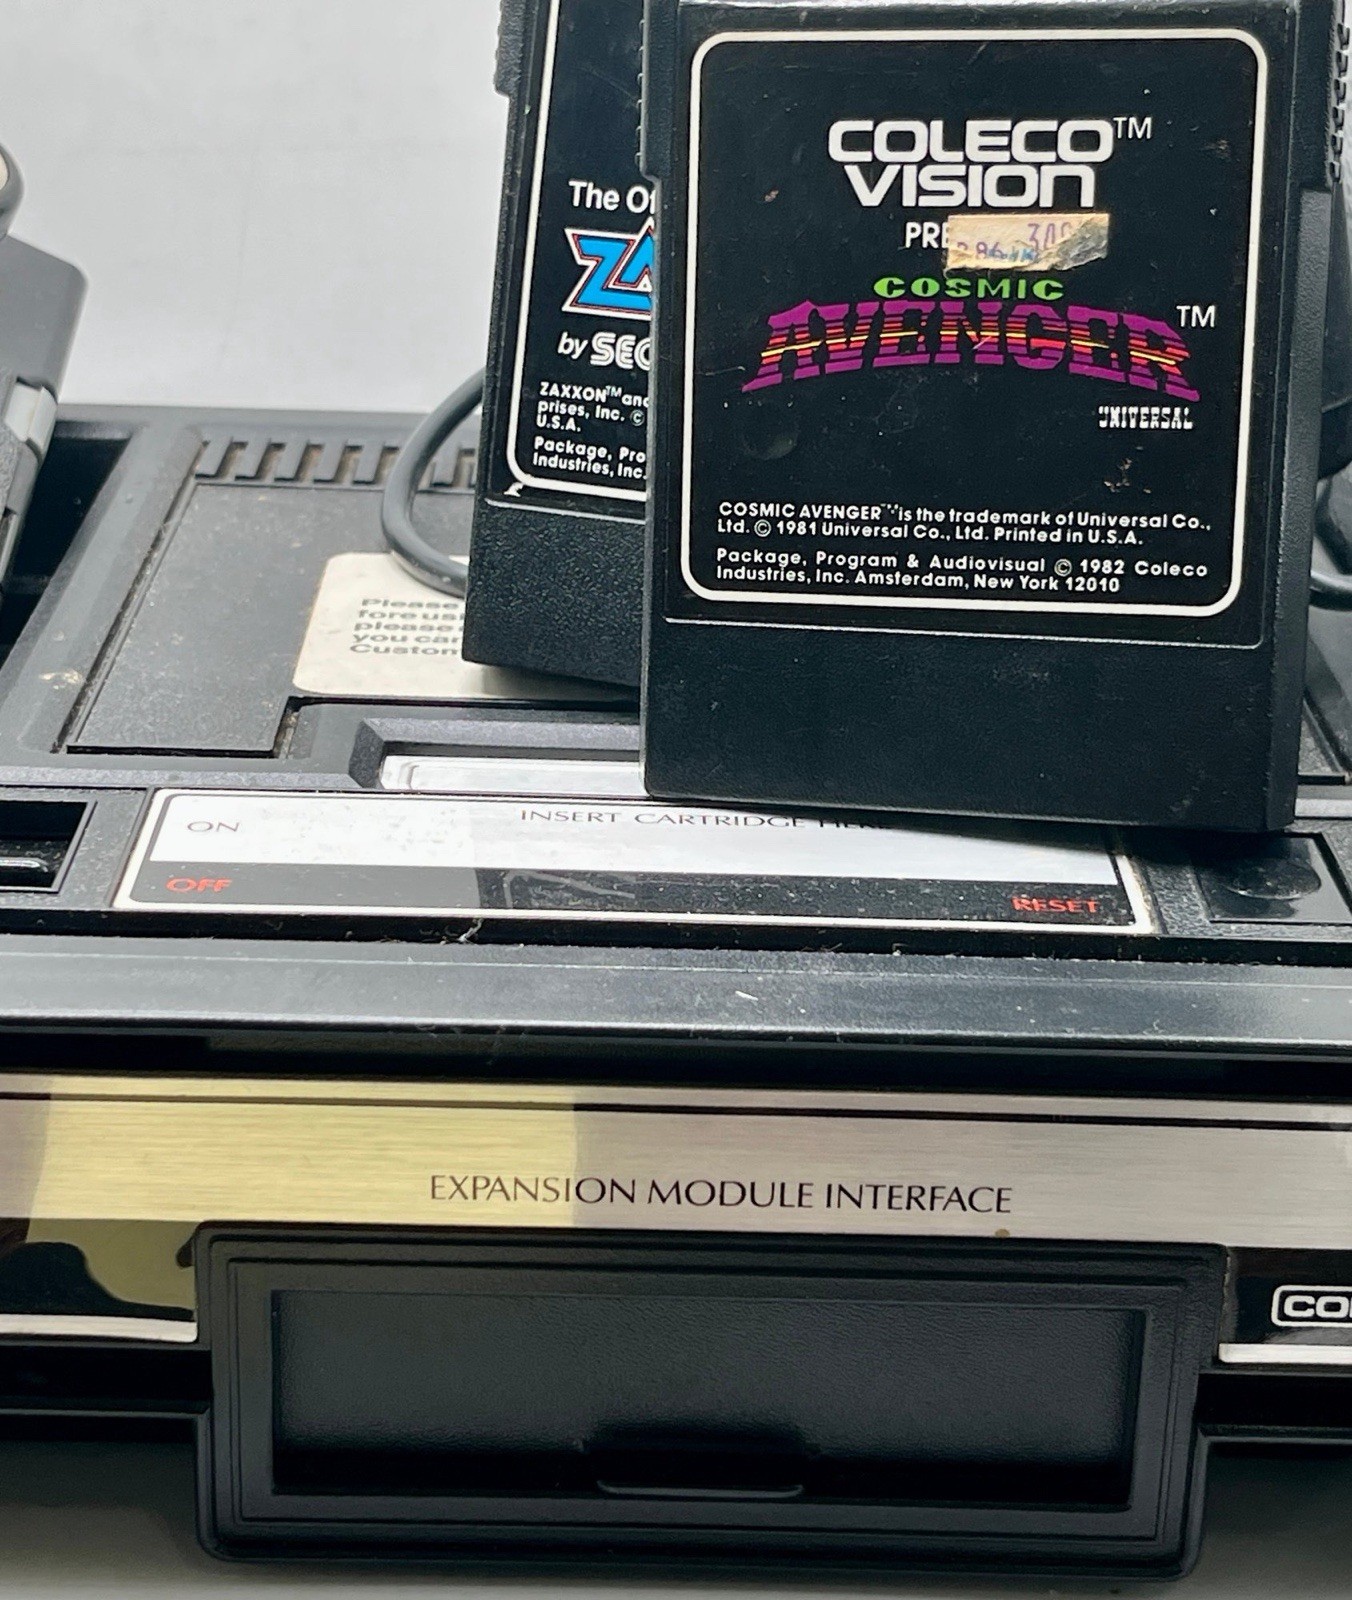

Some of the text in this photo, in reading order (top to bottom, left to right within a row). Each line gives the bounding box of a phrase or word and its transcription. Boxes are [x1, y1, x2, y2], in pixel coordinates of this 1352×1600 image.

[828, 119, 1114, 163] COLECO
[568, 180, 621, 211] The
[844, 164, 1096, 208] VISION
[873, 276, 1065, 300] COSMIC
[557, 330, 588, 360] by
[741, 299, 1216, 402] AVENGER TM
[536, 413, 581, 432] U.S.A.
[537, 400, 590, 420] prises,
[595, 404, 625, 422] Inc.
[1098, 405, 1193, 430] UNIVERSAL
[533, 435, 612, 462] Package,
[532, 452, 648, 480] Industries, Inc.
[719, 502, 795, 518] COSMIC
[898, 506, 912, 521] is
[916, 507, 945, 523] the
[949, 508, 1051, 526] trademark
[1055, 511, 1074, 526] of
[1077, 511, 1168, 528] Universal
[1171, 513, 1211, 532] Co.,
[717, 518, 750, 534] Ltd.
[776, 520, 818, 537] 1981
[821, 520, 909, 538] Universal
[913, 524, 951, 542] Co.,
[955, 525, 990, 541] Ltd.
[994, 526, 1062, 543] Printed
[1066, 529, 1083, 544] in
[1088, 529, 1144, 545] U.S.A.
[716, 547, 807, 568] Package,
[816, 550, 898, 571] Program
[906, 553, 920, 569] &
[929, 554, 1045, 573] Audiovisual
[1080, 558, 1125, 575] 1982
[1134, 560, 1208, 577] Coleco
[716, 565, 1120, 592] Industries, Inc. Amsterdam, New York 12010
[359, 609, 418, 619] fore
[361, 598, 459, 610] Please
[353, 633, 409, 643] you
[354, 620, 454, 631] please
[187, 820, 240, 833] ON
[520, 809, 622, 823] INSERT
[634, 812, 806, 828] CARTRIDGE
[165, 876, 233, 893] OFF
[1011, 896, 1099, 913] RESET
[430, 1175, 1012, 1214] EXPANSION MODULE INTERFACE
[1283, 1294, 1352, 1319] CO
